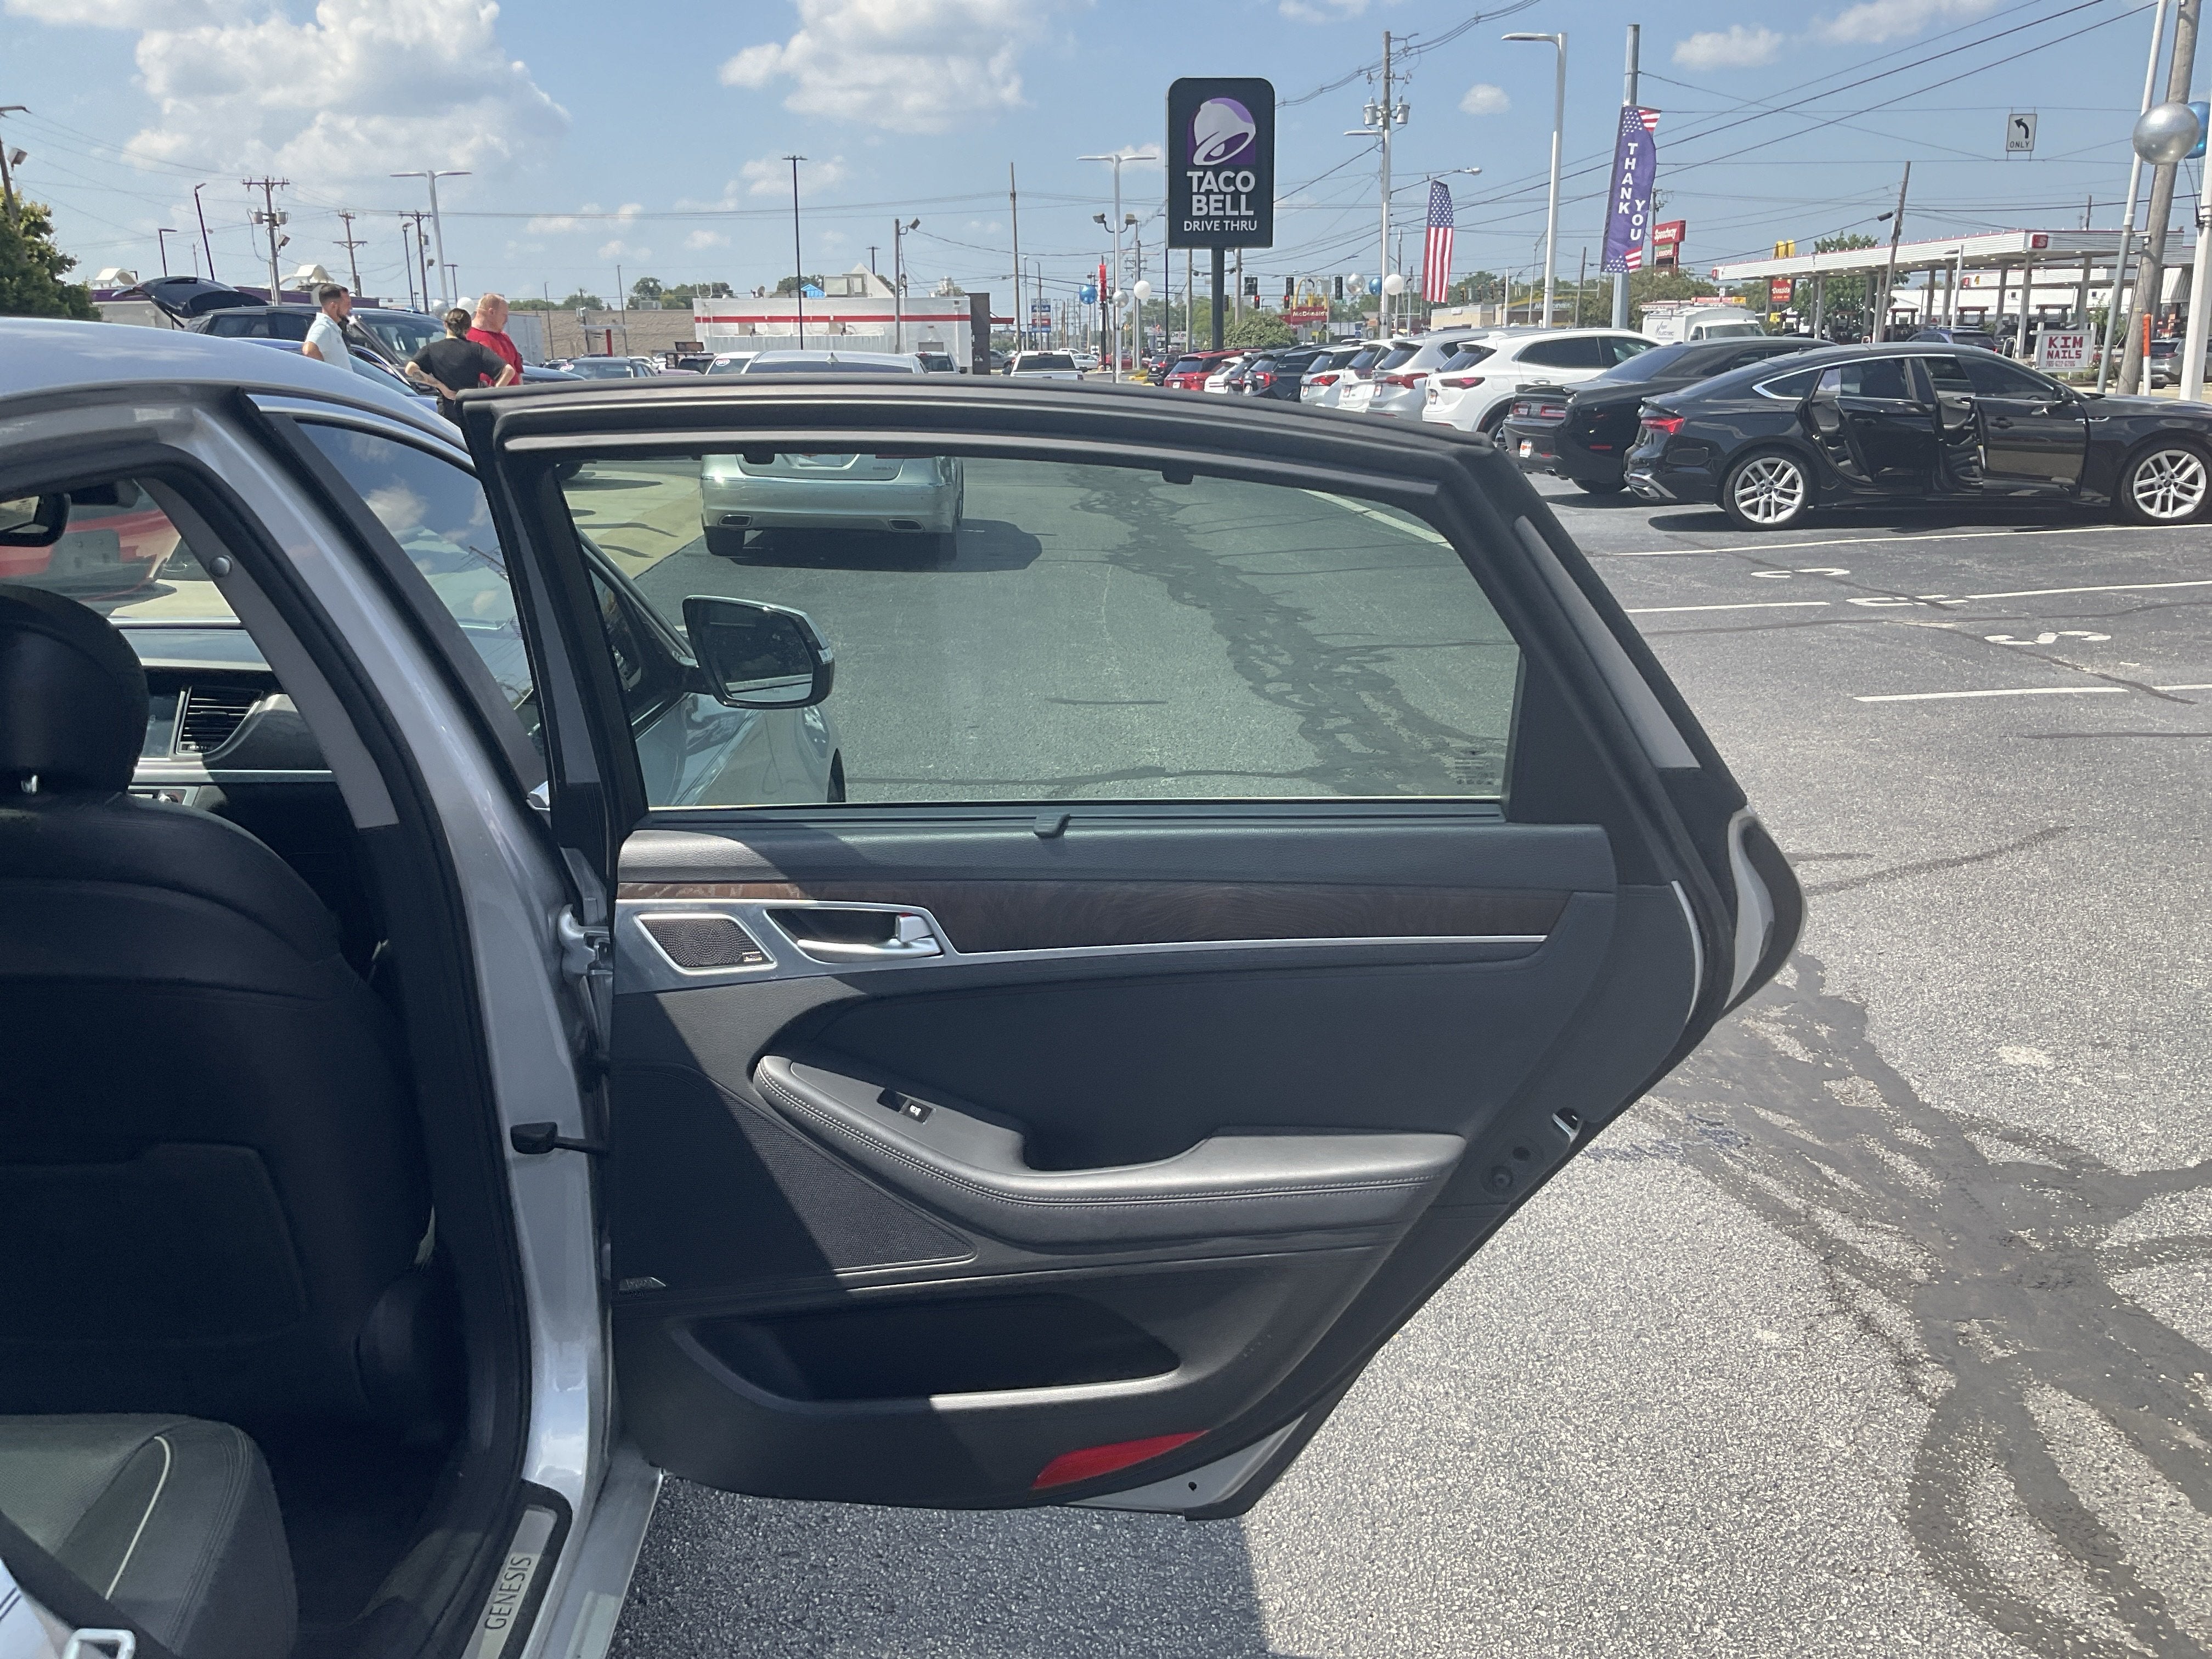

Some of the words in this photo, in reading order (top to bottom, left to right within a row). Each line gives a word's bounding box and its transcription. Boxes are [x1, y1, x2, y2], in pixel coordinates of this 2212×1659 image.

[1187, 170, 1256, 193] TACO
[1618, 142, 1639, 215] THANK
[1192, 195, 1254, 216] BELL
[1184, 220, 1221, 232] DRIVE
[1223, 220, 1257, 232] THRU
[1630, 199, 1647, 241] YOU
[1656, 249, 1673, 257] LIQUORS
[2048, 336, 2084, 348] KIM
[2047, 350, 2082, 359] NAILS
[484, 1556, 532, 1629] GENESIS
